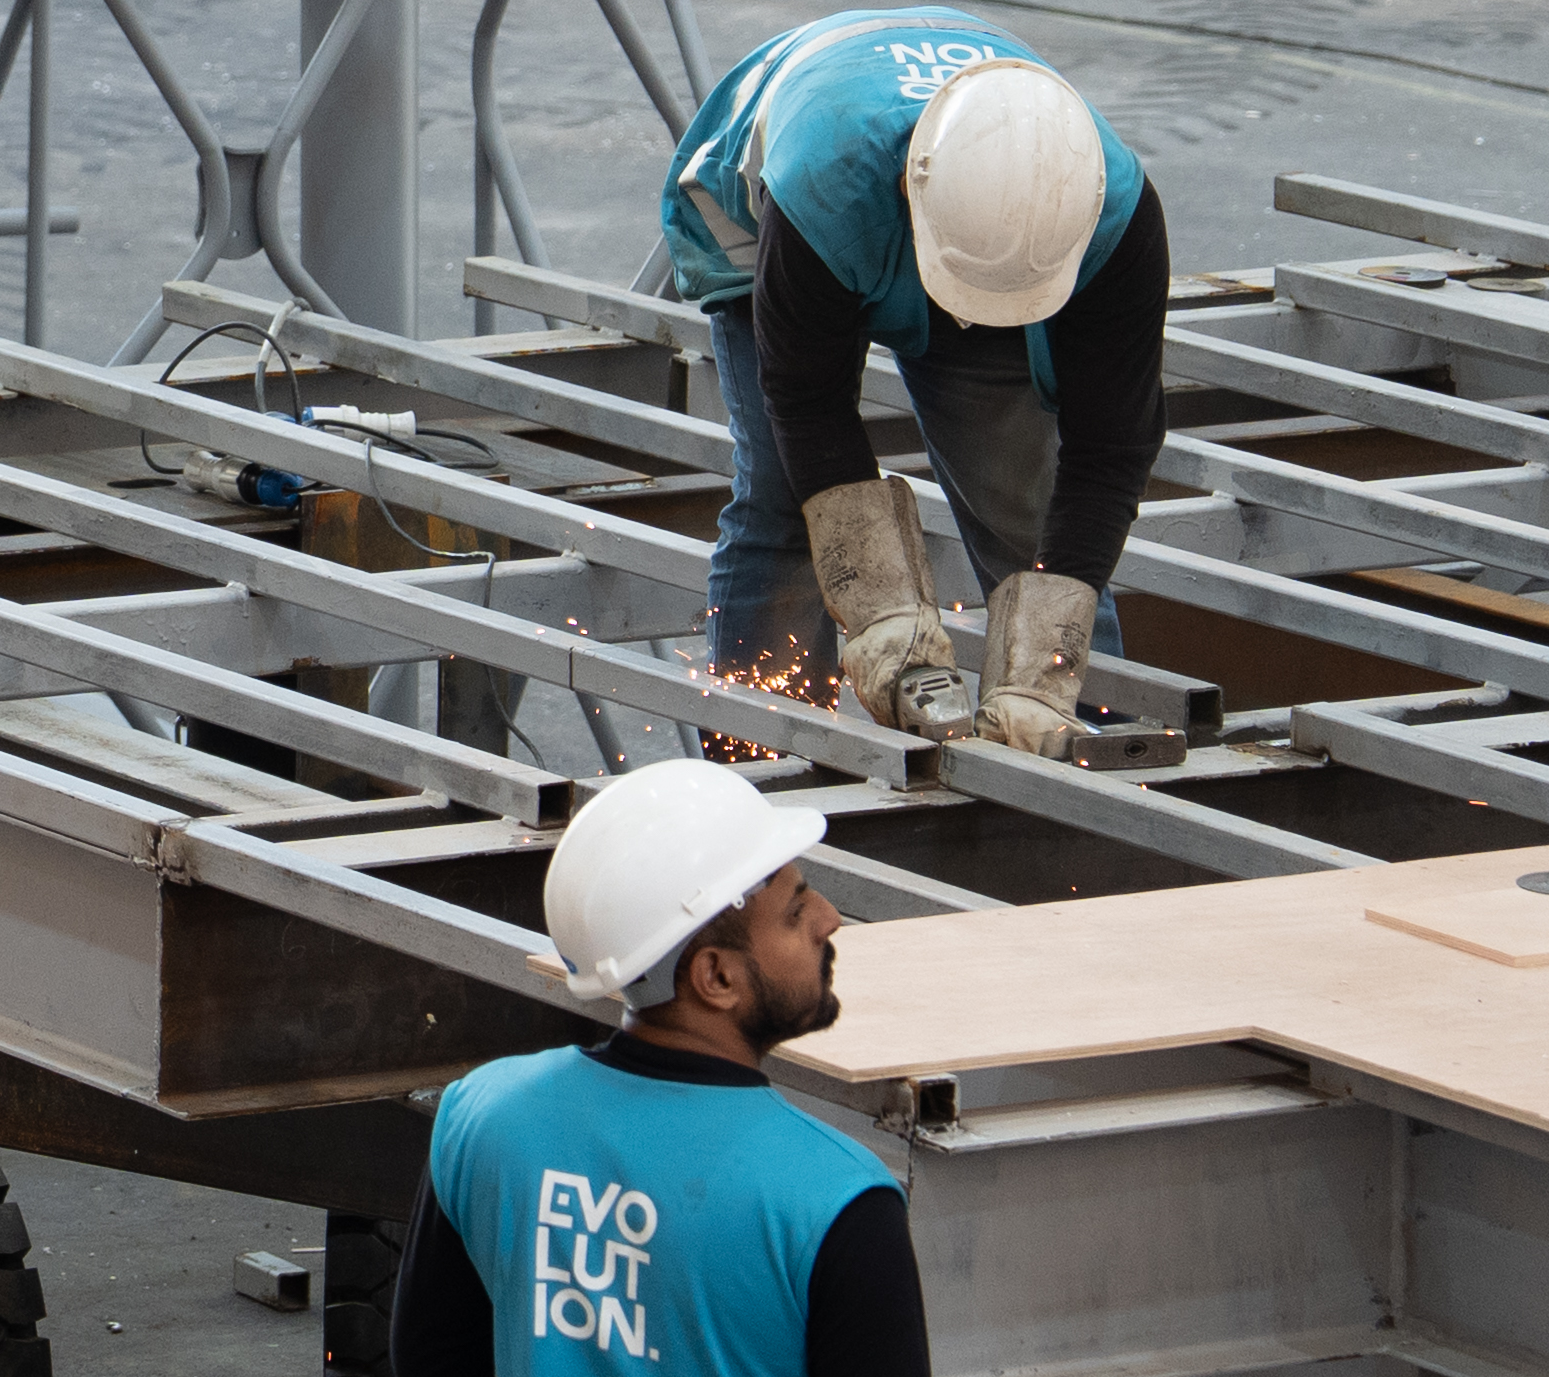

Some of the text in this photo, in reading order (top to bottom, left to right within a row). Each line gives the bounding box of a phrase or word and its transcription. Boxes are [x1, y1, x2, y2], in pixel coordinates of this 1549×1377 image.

[897, 63, 960, 85] UT
[538, 1169, 658, 1246] EVO
[535, 1226, 651, 1301] LUT
[534, 1282, 660, 1362] ION.
